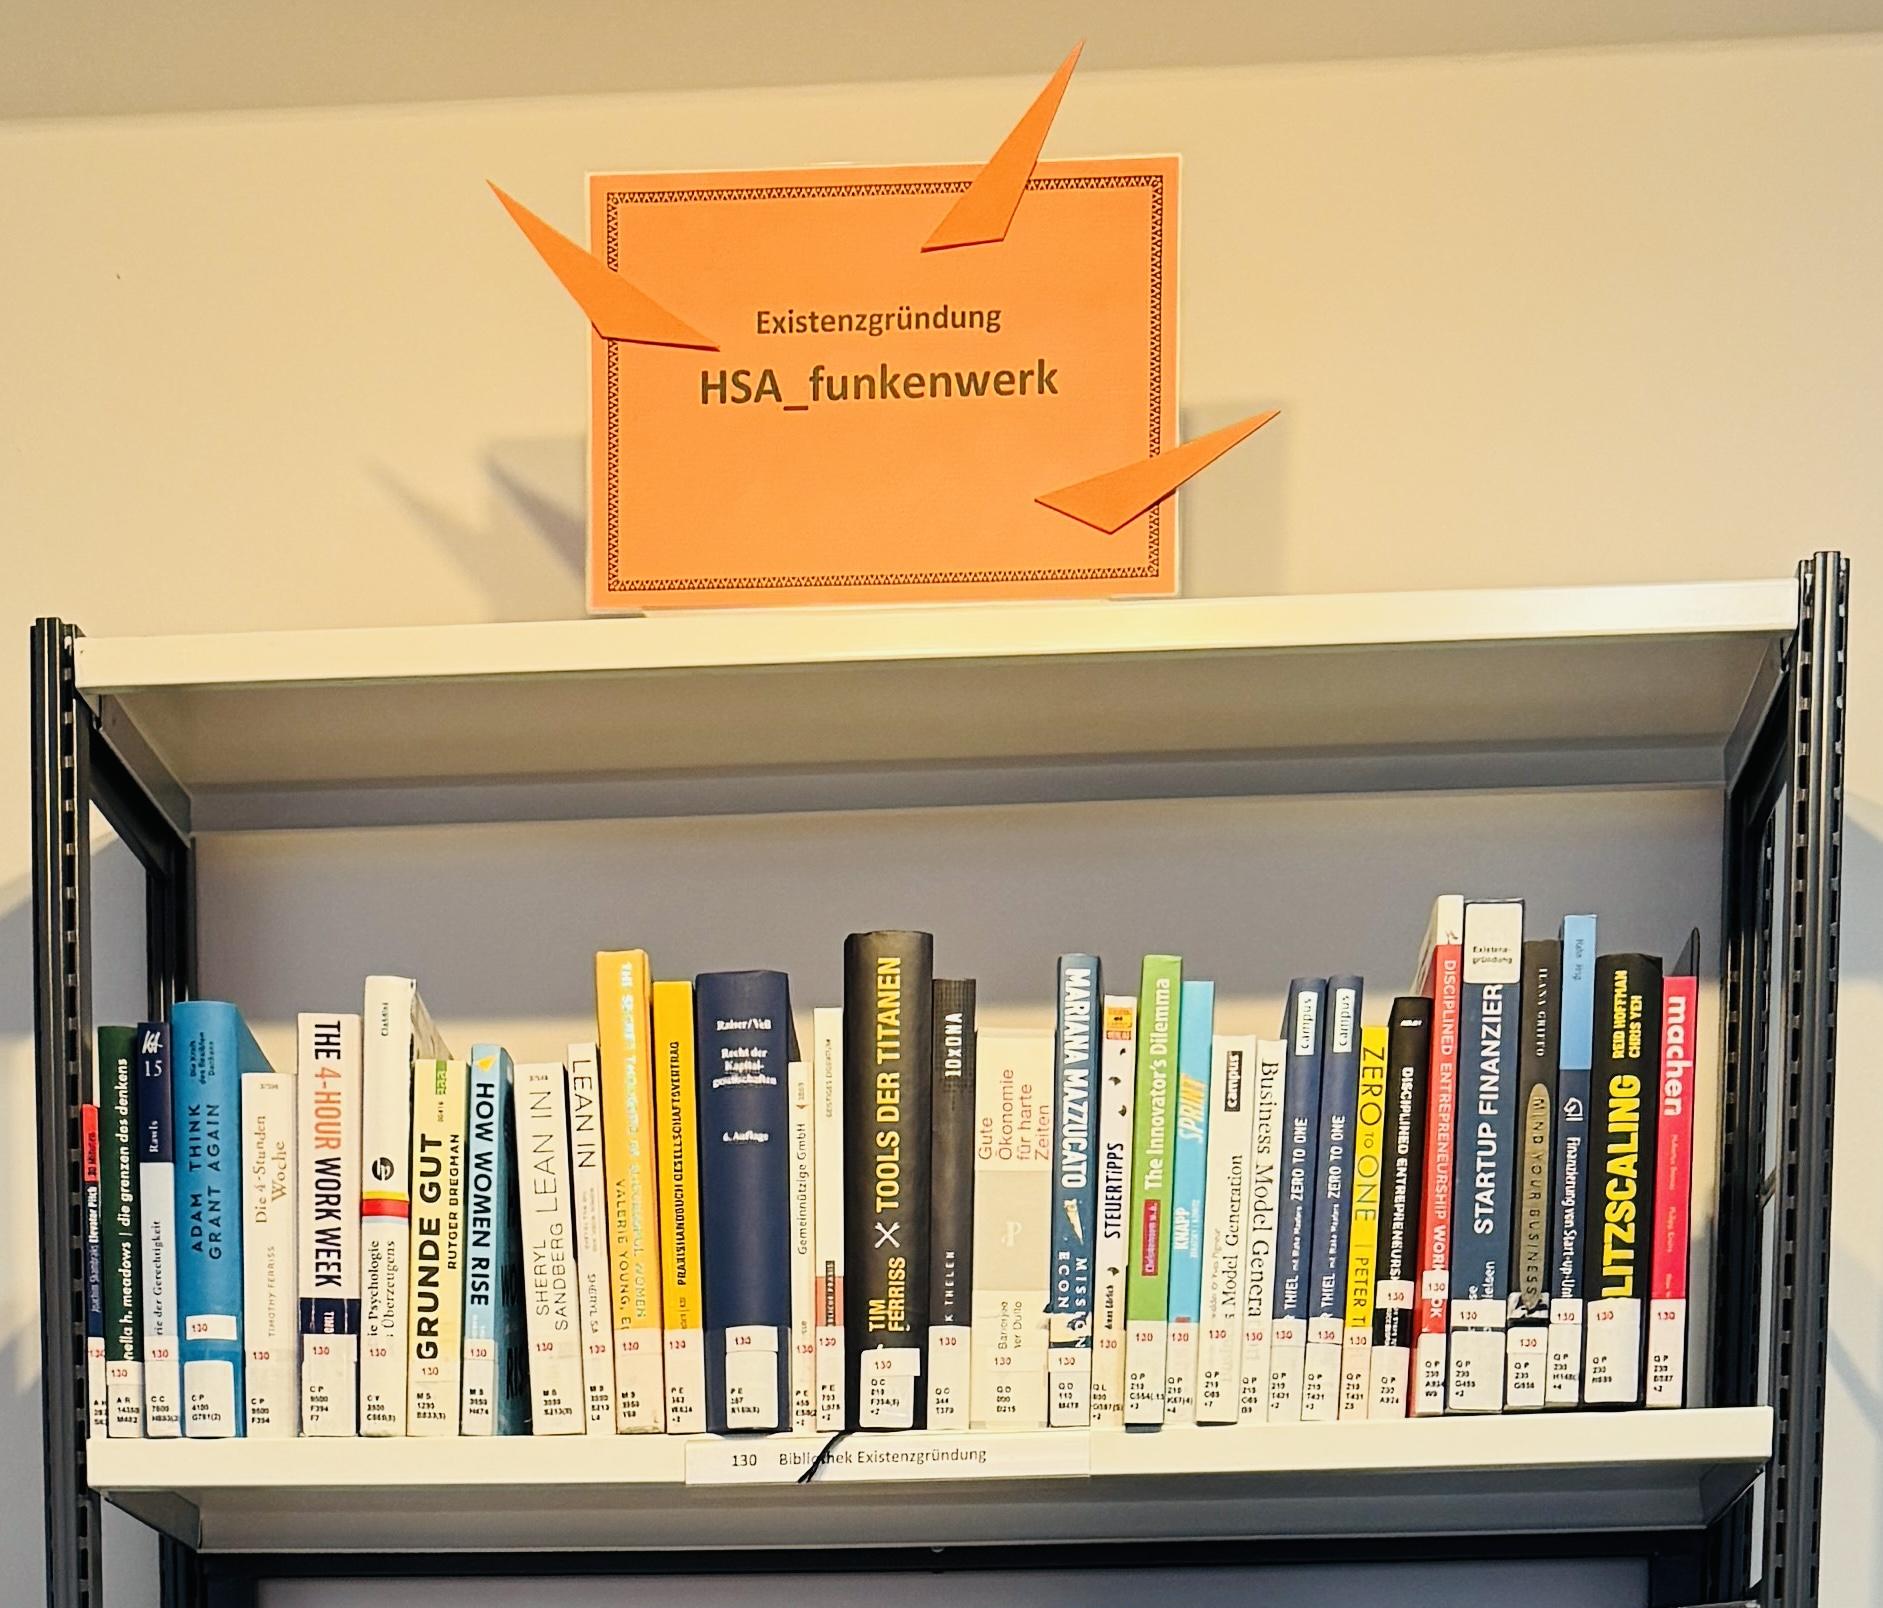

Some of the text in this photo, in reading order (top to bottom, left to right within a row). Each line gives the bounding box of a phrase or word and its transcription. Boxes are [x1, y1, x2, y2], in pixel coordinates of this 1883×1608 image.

[755, 303, 1001, 336] Existenzgründung
[700, 359, 1058, 411] HSA_funkenwerk
[945, 1012, 963, 1078] 10xDNA
[1062, 968, 1090, 1188] MARIANA MAZZUCATO
[1663, 996, 1688, 1115] machen
[875, 956, 901, 1213] TOOLS DER TITANEN
[997, 1069, 1015, 1160] Ökonomie
[1144, 978, 1170, 1190] The Innovator's Dilemma
[148, 1120, 159, 1153] Rawls
[188, 1104, 201, 1172] THINK
[205, 1104, 220, 1171] AGAIN
[314, 1021, 342, 1287] THE 4-HOUR WORK WEEK
[529, 1091, 557, 1213] LEAN IN
[978, 1117, 994, 1160] Gute
[1016, 1084, 1032, 1160] für harte
[1035, 1104, 1050, 1160] Zeiten
[270, 1142, 286, 1200] Woche
[420, 1133, 442, 1205] GUT
[470, 1083, 494, 1305] HOW WOMEN RISE
[794, 1123, 809, 1255] Gemeinnützige GmbH
[1353, 1046, 1385, 1307] ZERO TO ONE PETER
[1472, 1123, 1497, 1235] STARTUP
[189, 1193, 204, 1252] ADAM
[207, 1186, 222, 1260] GRANT
[1174, 1207, 1190, 1250] KNAPP
[1223, 1155, 1243, 1307] Model Generation
[532, 1239, 549, 1315] SHERYL
[549, 1223, 569, 1330] SANDBERG
[887, 1256, 906, 1331] FERRISS
[869, 1300, 887, 1332] TIM
[731, 1455, 758, 1467] 130
[857, 1448, 987, 1464] Existenzgründung
